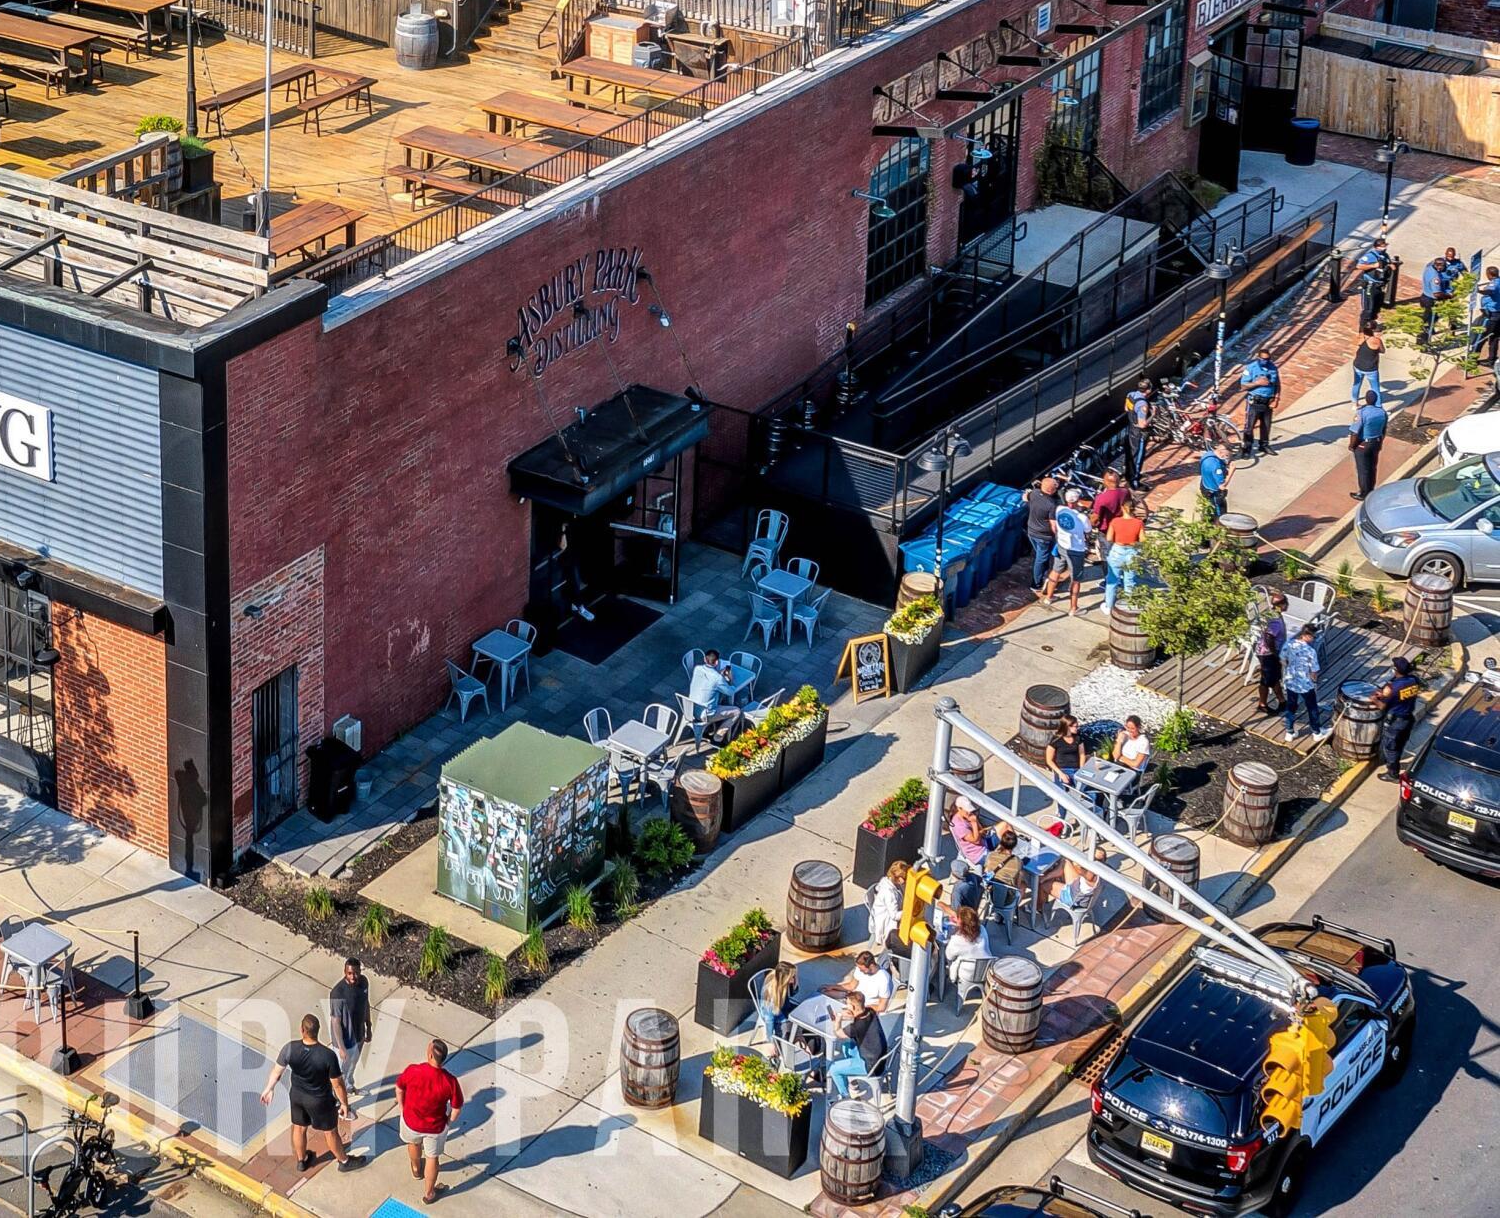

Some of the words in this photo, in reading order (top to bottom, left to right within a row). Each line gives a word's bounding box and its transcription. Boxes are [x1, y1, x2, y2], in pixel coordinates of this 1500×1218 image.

[510, 254, 590, 373] ASBURY
[592, 245, 644, 306] PARK
[533, 295, 621, 379] DISTILLING
[1413, 780, 1456, 804] POLICE
[1318, 1037, 1384, 1126] POLICE
[1101, 1108, 1114, 1123] 21
[1103, 1091, 1150, 1123] POLICE
[1169, 1123, 1228, 1149] 732-774-1300
[1266, 1129, 1280, 1145] 911
